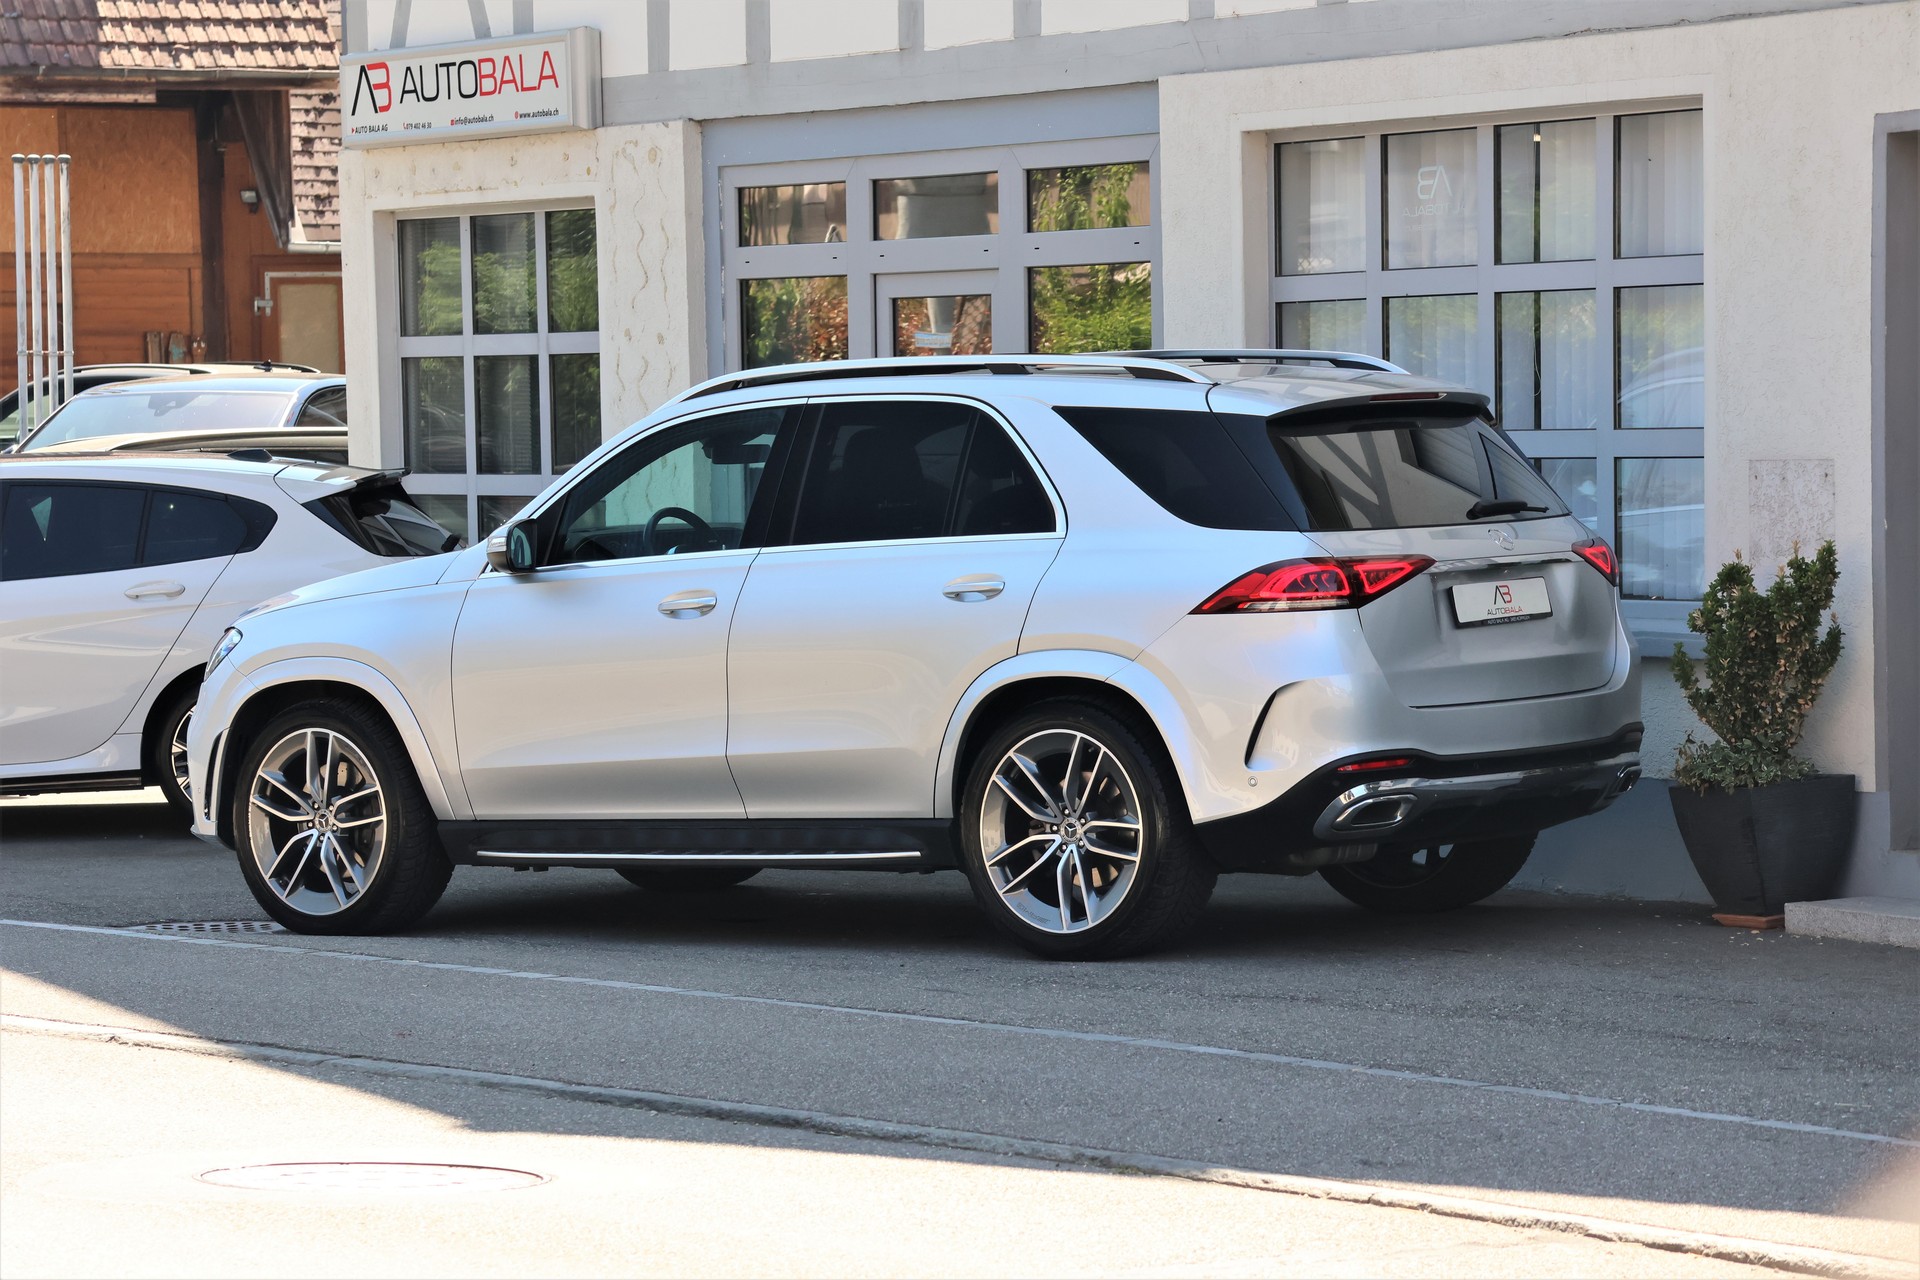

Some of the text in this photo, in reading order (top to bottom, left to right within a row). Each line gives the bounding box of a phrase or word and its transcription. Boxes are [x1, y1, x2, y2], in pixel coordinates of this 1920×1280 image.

[400, 51, 559, 104] AUTOBALA
[519, 108, 559, 119] www.autobala.ch
[454, 114, 494, 126] info@autobala.ch
[355, 124, 388, 134] AUTO BALA AG
[1487, 606, 1523, 616] AUTOBALA
